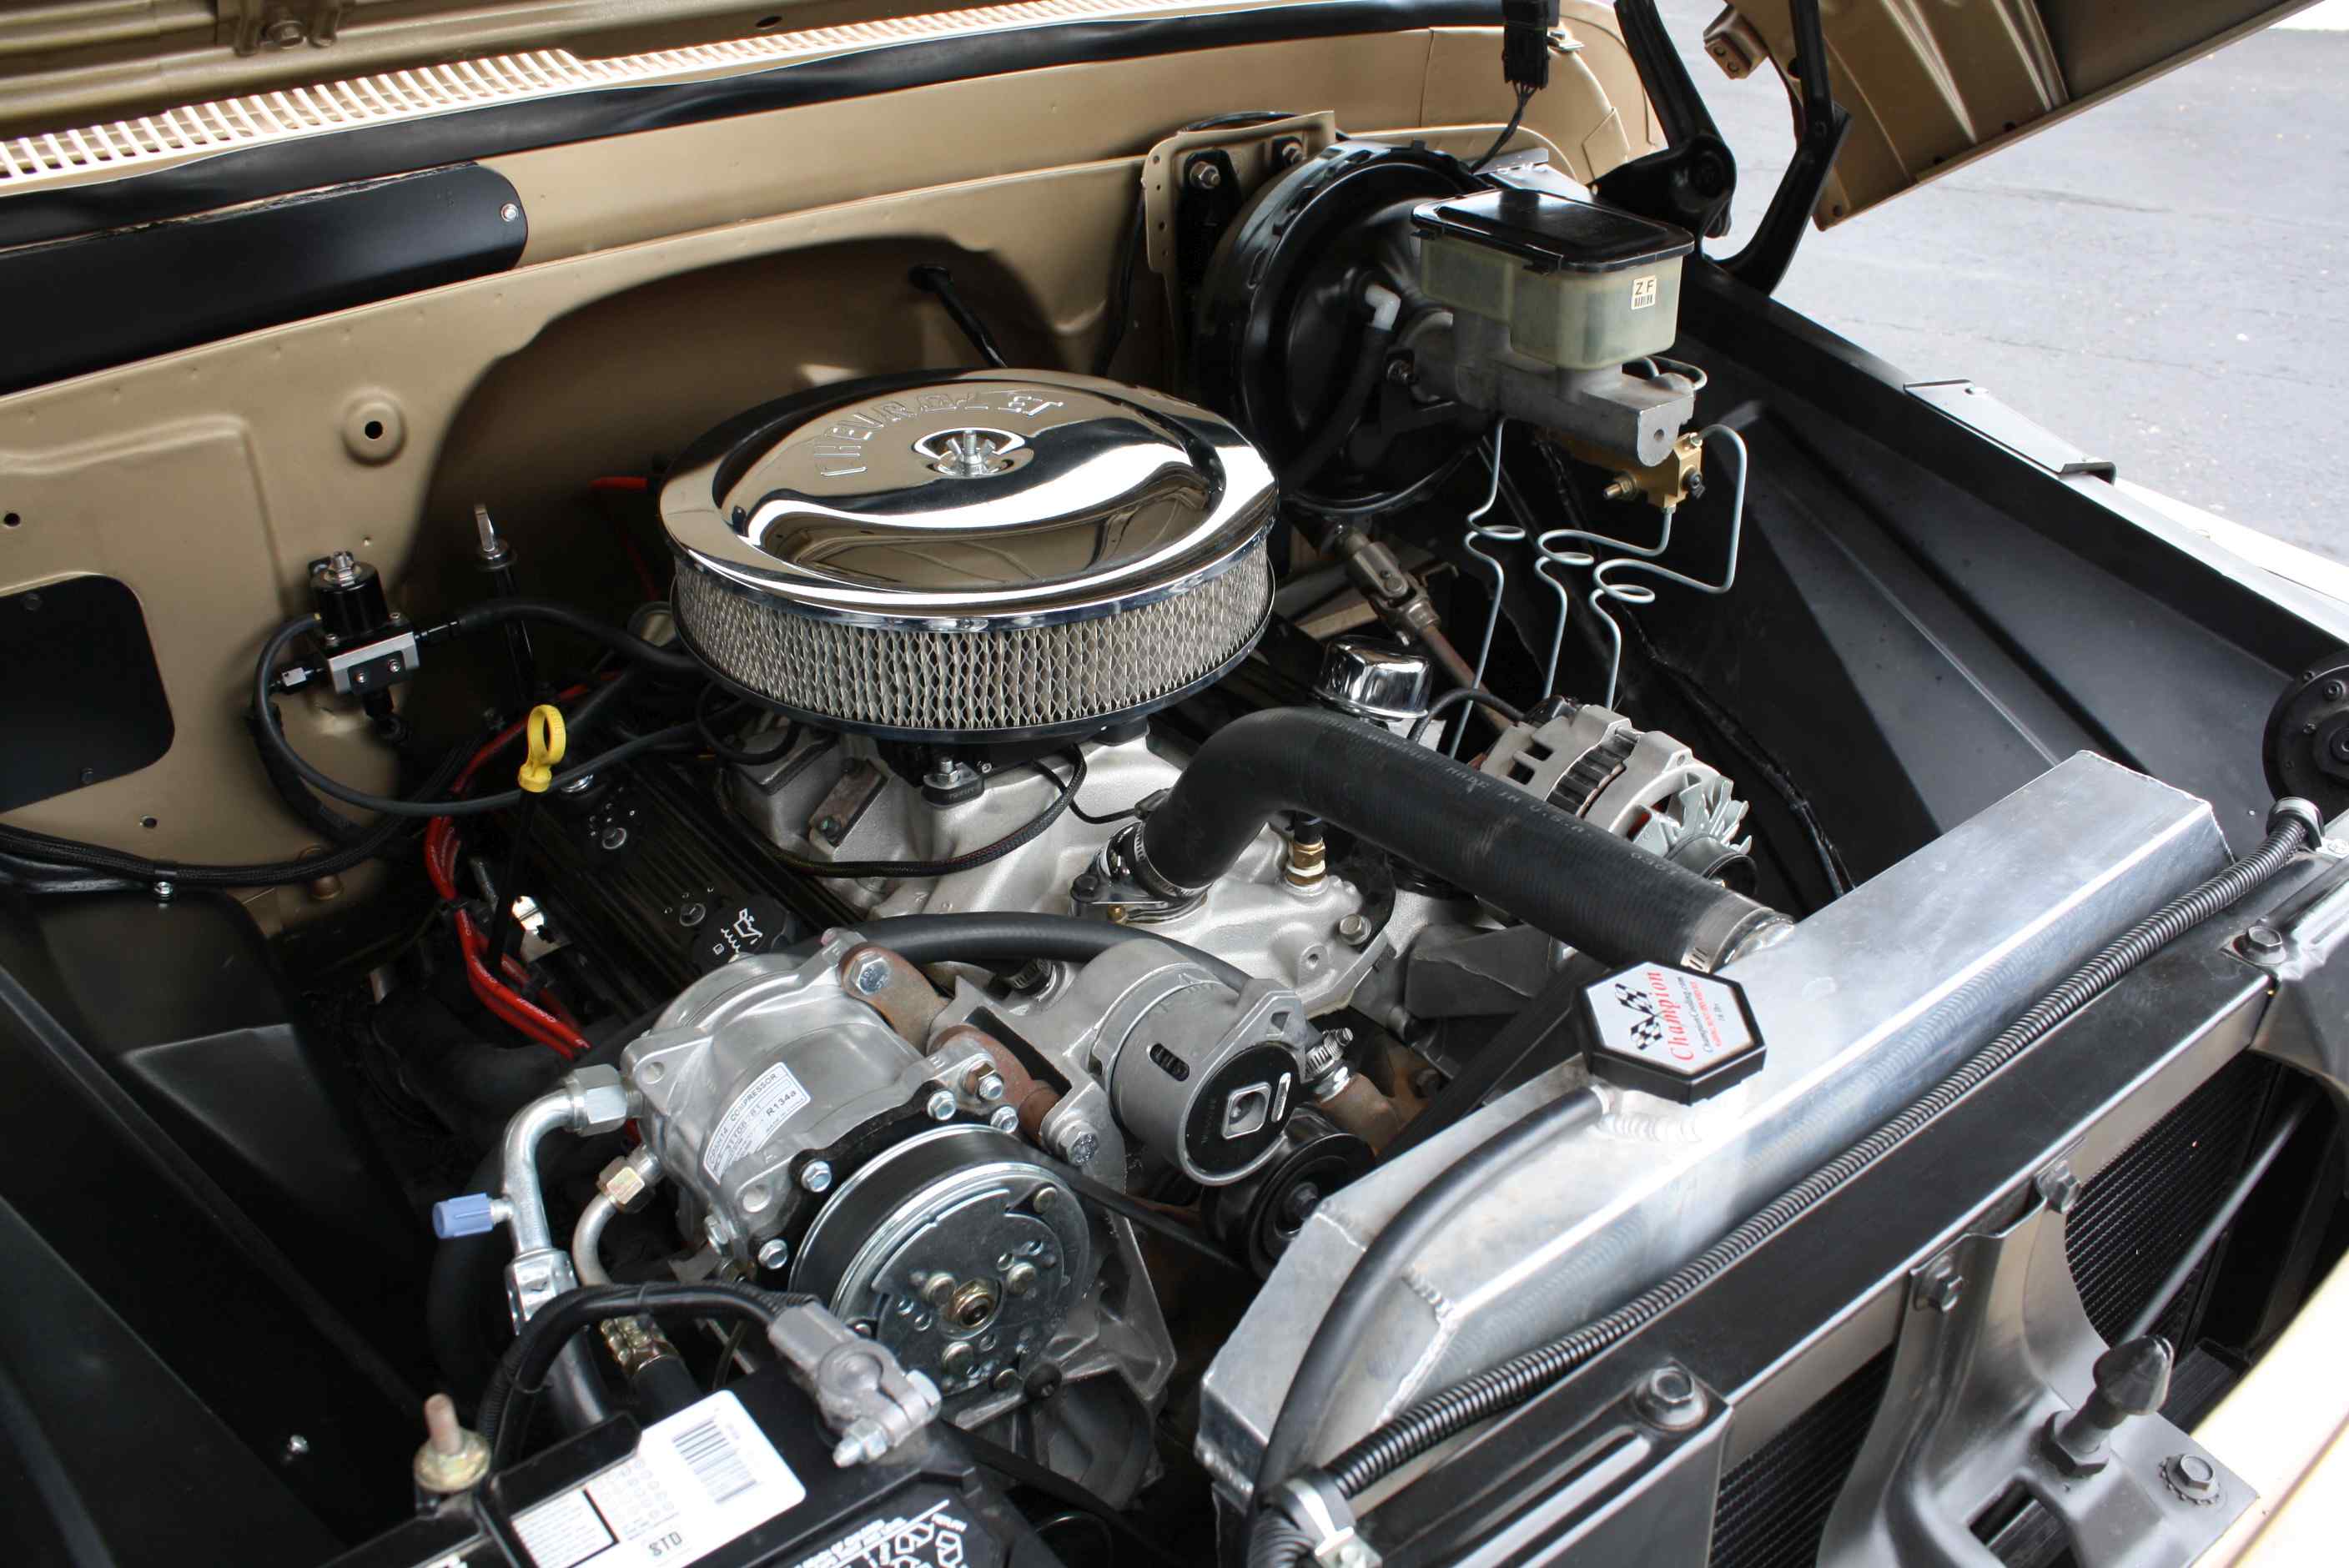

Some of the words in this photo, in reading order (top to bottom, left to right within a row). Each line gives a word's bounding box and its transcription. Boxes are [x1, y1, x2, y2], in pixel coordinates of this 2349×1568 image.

[1647, 972, 1694, 1061] Champion
[731, 1073, 777, 1122] COMPRESSOR
[766, 1089, 797, 1117] R134a
[648, 1530, 683, 1557] STD
